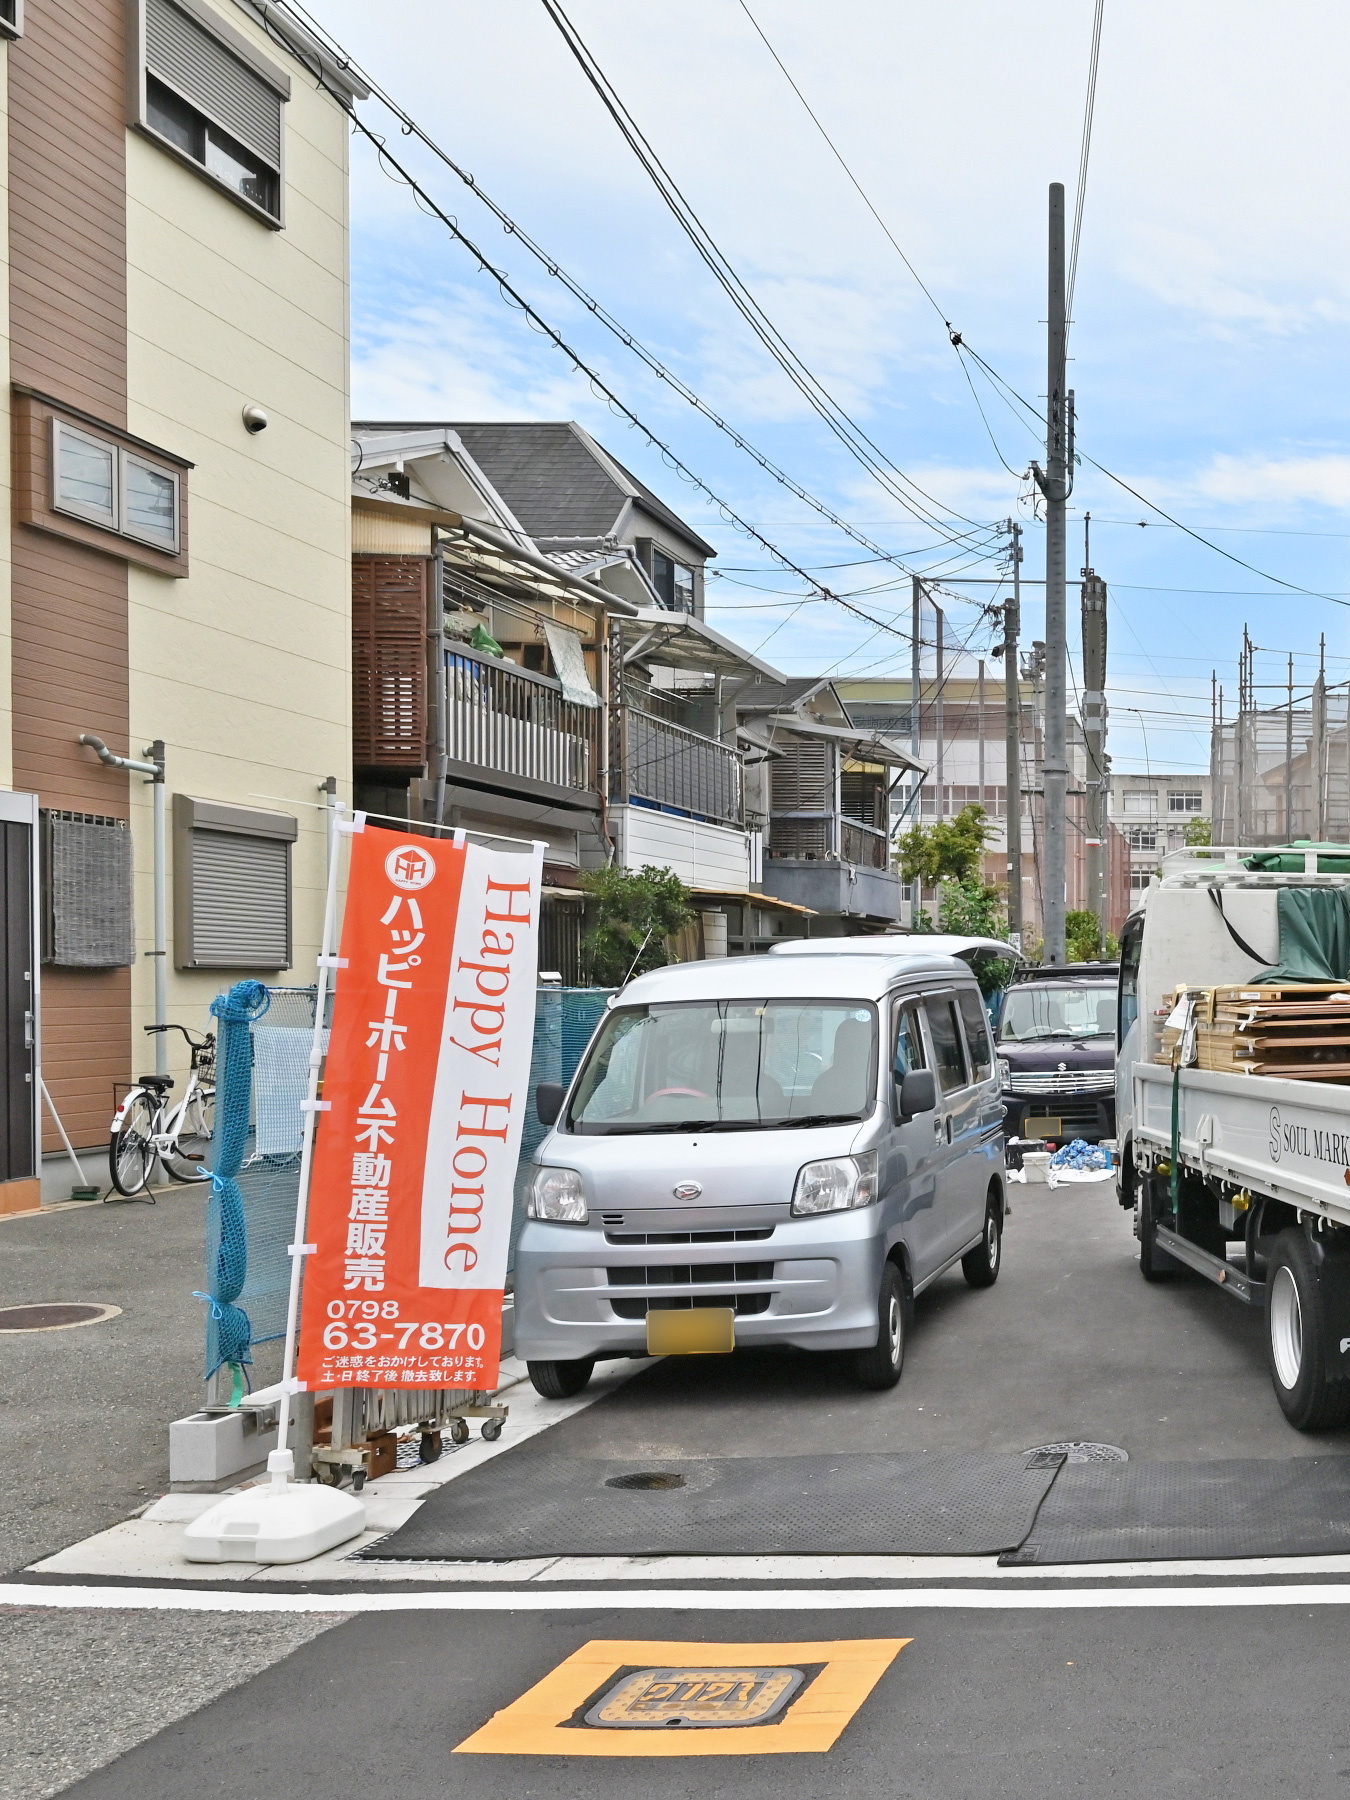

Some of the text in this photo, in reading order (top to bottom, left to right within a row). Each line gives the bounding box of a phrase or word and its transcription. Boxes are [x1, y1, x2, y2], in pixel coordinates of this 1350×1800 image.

[444, 874, 531, 1273] Happy Home
[344, 895, 425, 1292] ハッピーホーム不動産販売
[1284, 1123, 1310, 1157] SOUL
[327, 1299, 399, 1320] 0798
[323, 1321, 485, 1350] 63-7870
[322, 1355, 484, 1369] ご迷惑をおかけしております。
